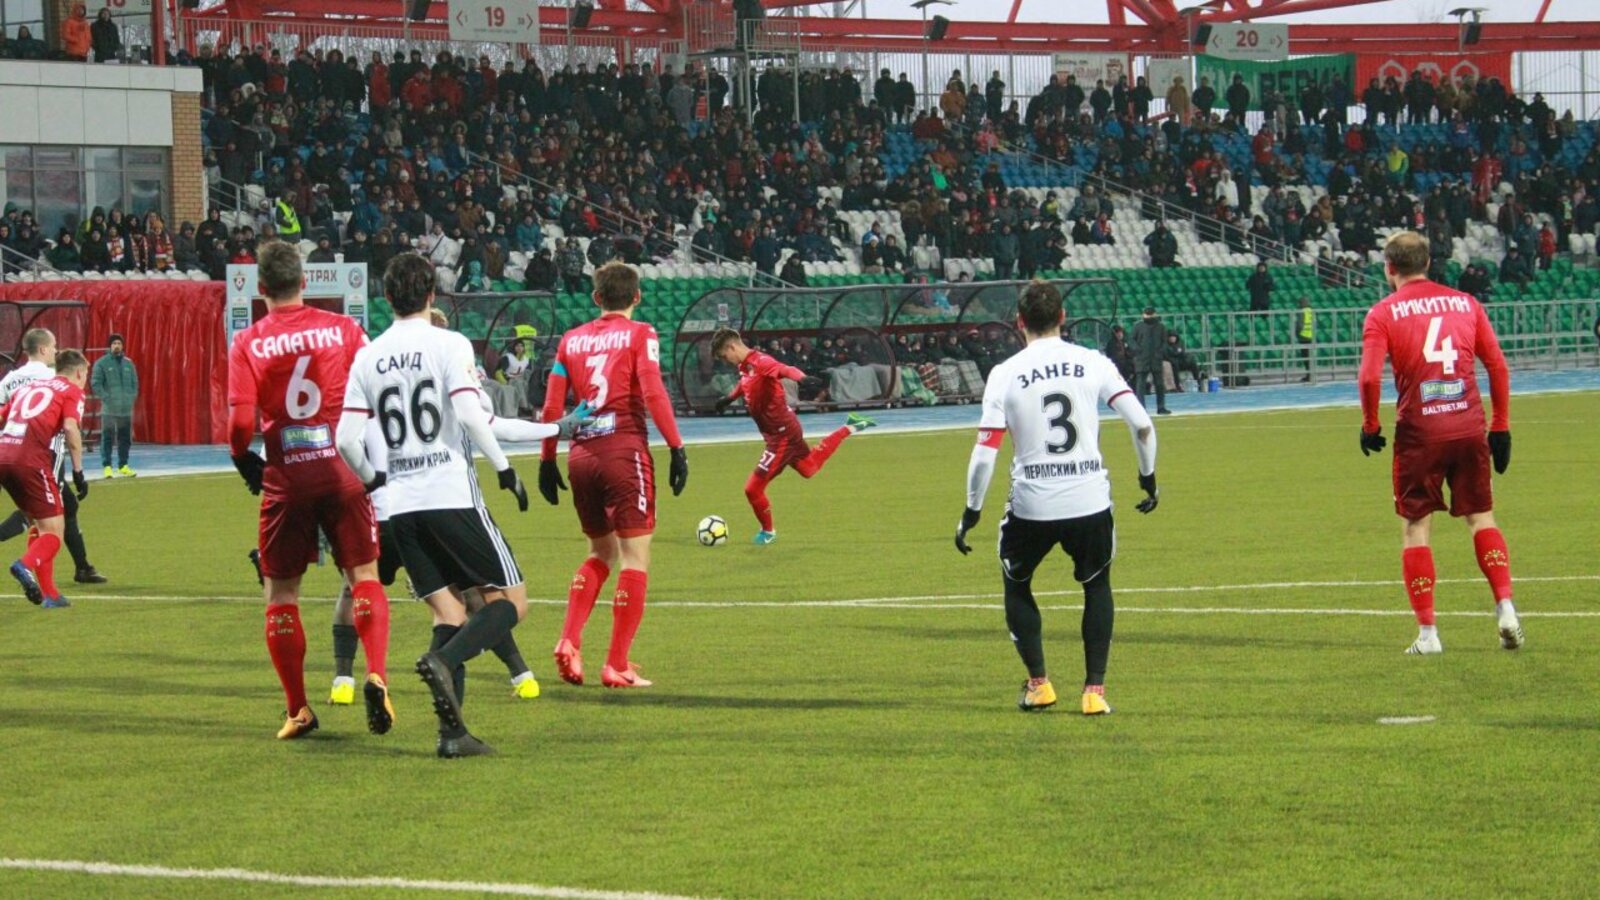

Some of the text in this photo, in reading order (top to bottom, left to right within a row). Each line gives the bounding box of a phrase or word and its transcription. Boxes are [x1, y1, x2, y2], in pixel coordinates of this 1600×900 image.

[485, 6, 505, 28] 19
[1236, 30, 1258, 48] 20
[1391, 296, 1471, 321] НИКИТИН
[251, 326, 344, 358] САЛАТИЧ
[566, 330, 632, 356] АЛИКИН
[1422, 316, 1459, 375] 4
[376, 352, 422, 375] САИД
[1017, 362, 1086, 389] ЗАНЕВ
[285, 355, 322, 421] 6
[585, 354, 609, 412] 3
[377, 378, 441, 451] 66
[1422, 402, 1468, 416] BALTBET.RU
[1042, 390, 1079, 456] 3
[284, 448, 336, 465] BALTBET.RU
[426, 449, 452, 468] КРАЙ
[1024, 463, 1078, 480] ПЕРМСКИЙ
